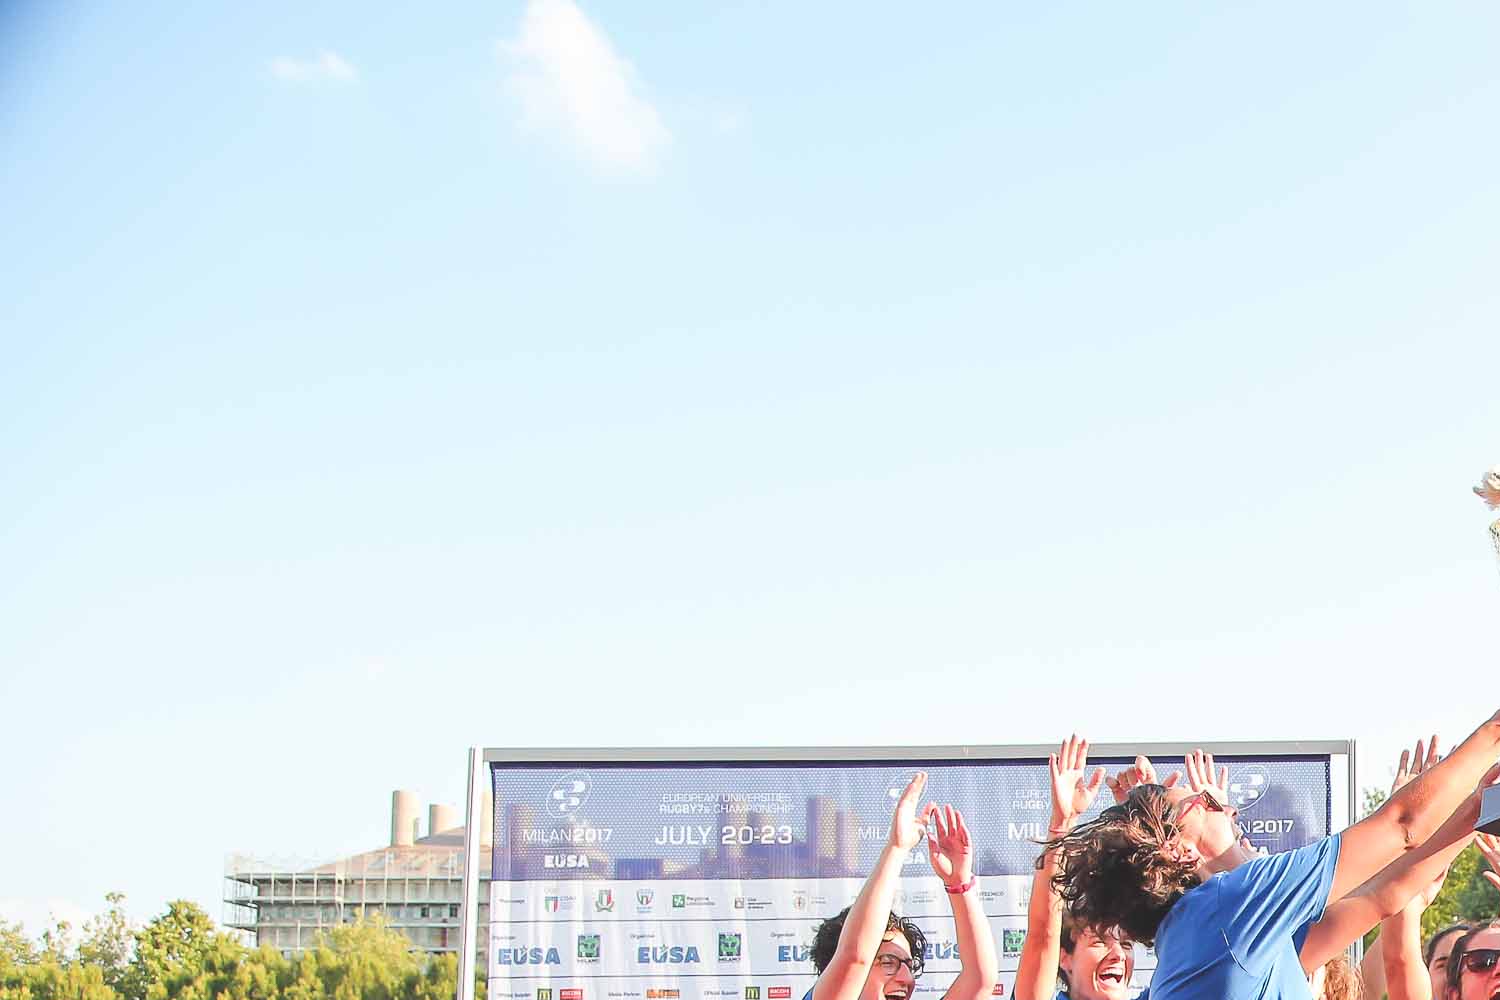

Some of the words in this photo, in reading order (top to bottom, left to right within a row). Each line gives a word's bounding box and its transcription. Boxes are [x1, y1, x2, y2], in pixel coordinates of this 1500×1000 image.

[522, 828, 614, 843] MILAN2017
[655, 825, 714, 845] JULY
[721, 825, 793, 845] 20-23
[544, 854, 590, 869] EUSA
[497, 946, 561, 965] EUSA
[637, 943, 701, 964] EUSA
